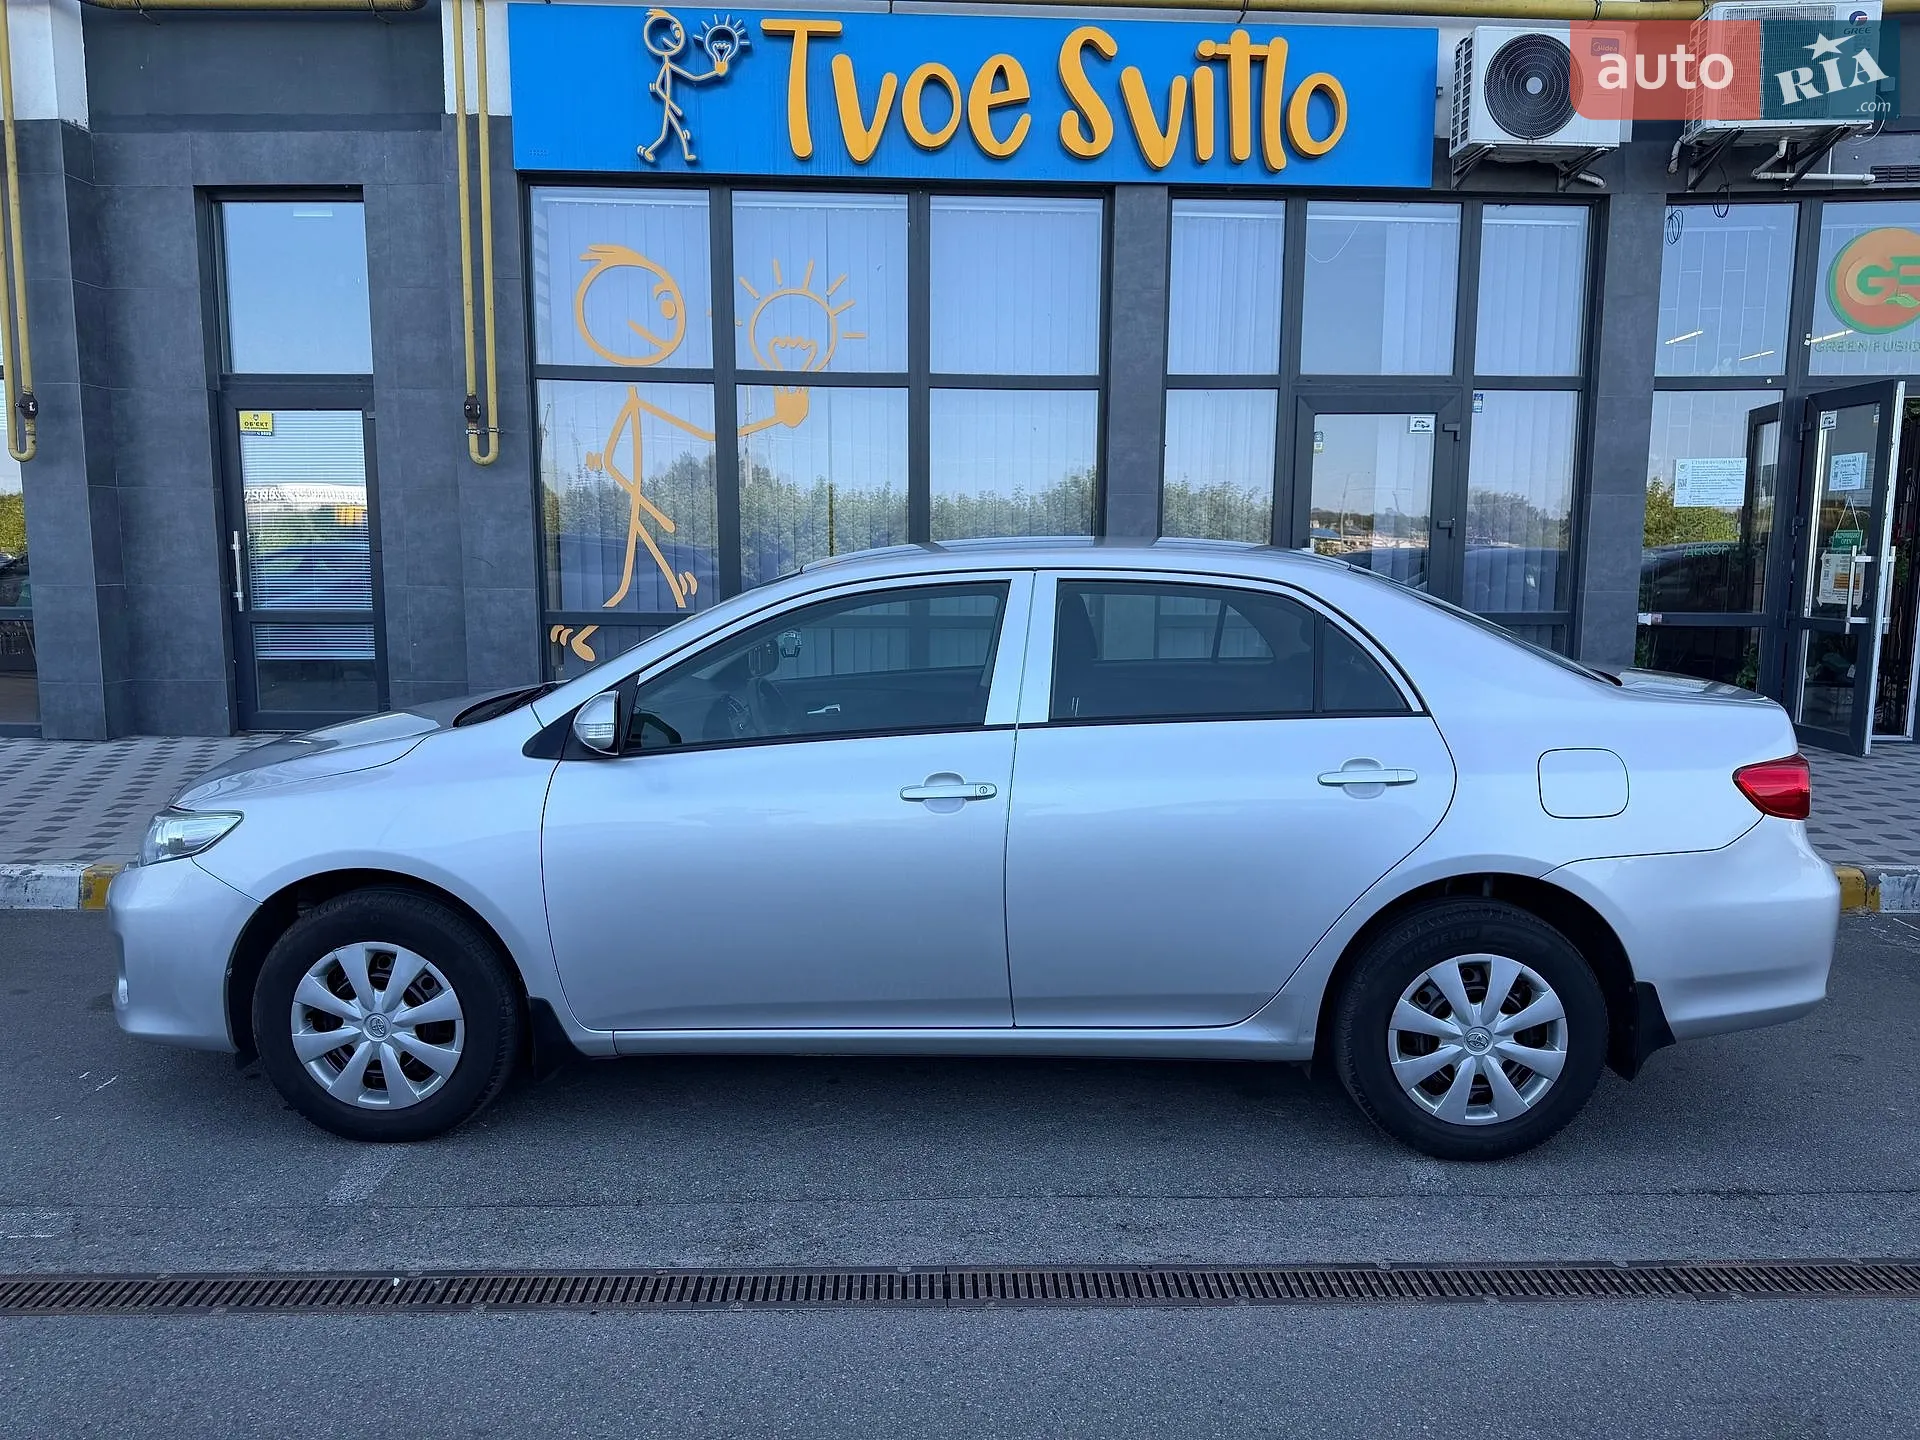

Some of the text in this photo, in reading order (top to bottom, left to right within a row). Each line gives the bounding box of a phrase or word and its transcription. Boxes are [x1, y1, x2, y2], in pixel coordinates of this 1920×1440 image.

[1843, 26, 1872, 35] GREE
[1592, 41, 1618, 52] Midea
[760, 18, 1348, 172] Tvoe Svitlo
[1814, 339, 1867, 353] GREEN
[1683, 543, 1729, 558] ДЕКОР
[1401, 927, 1479, 968] MICHELIN
